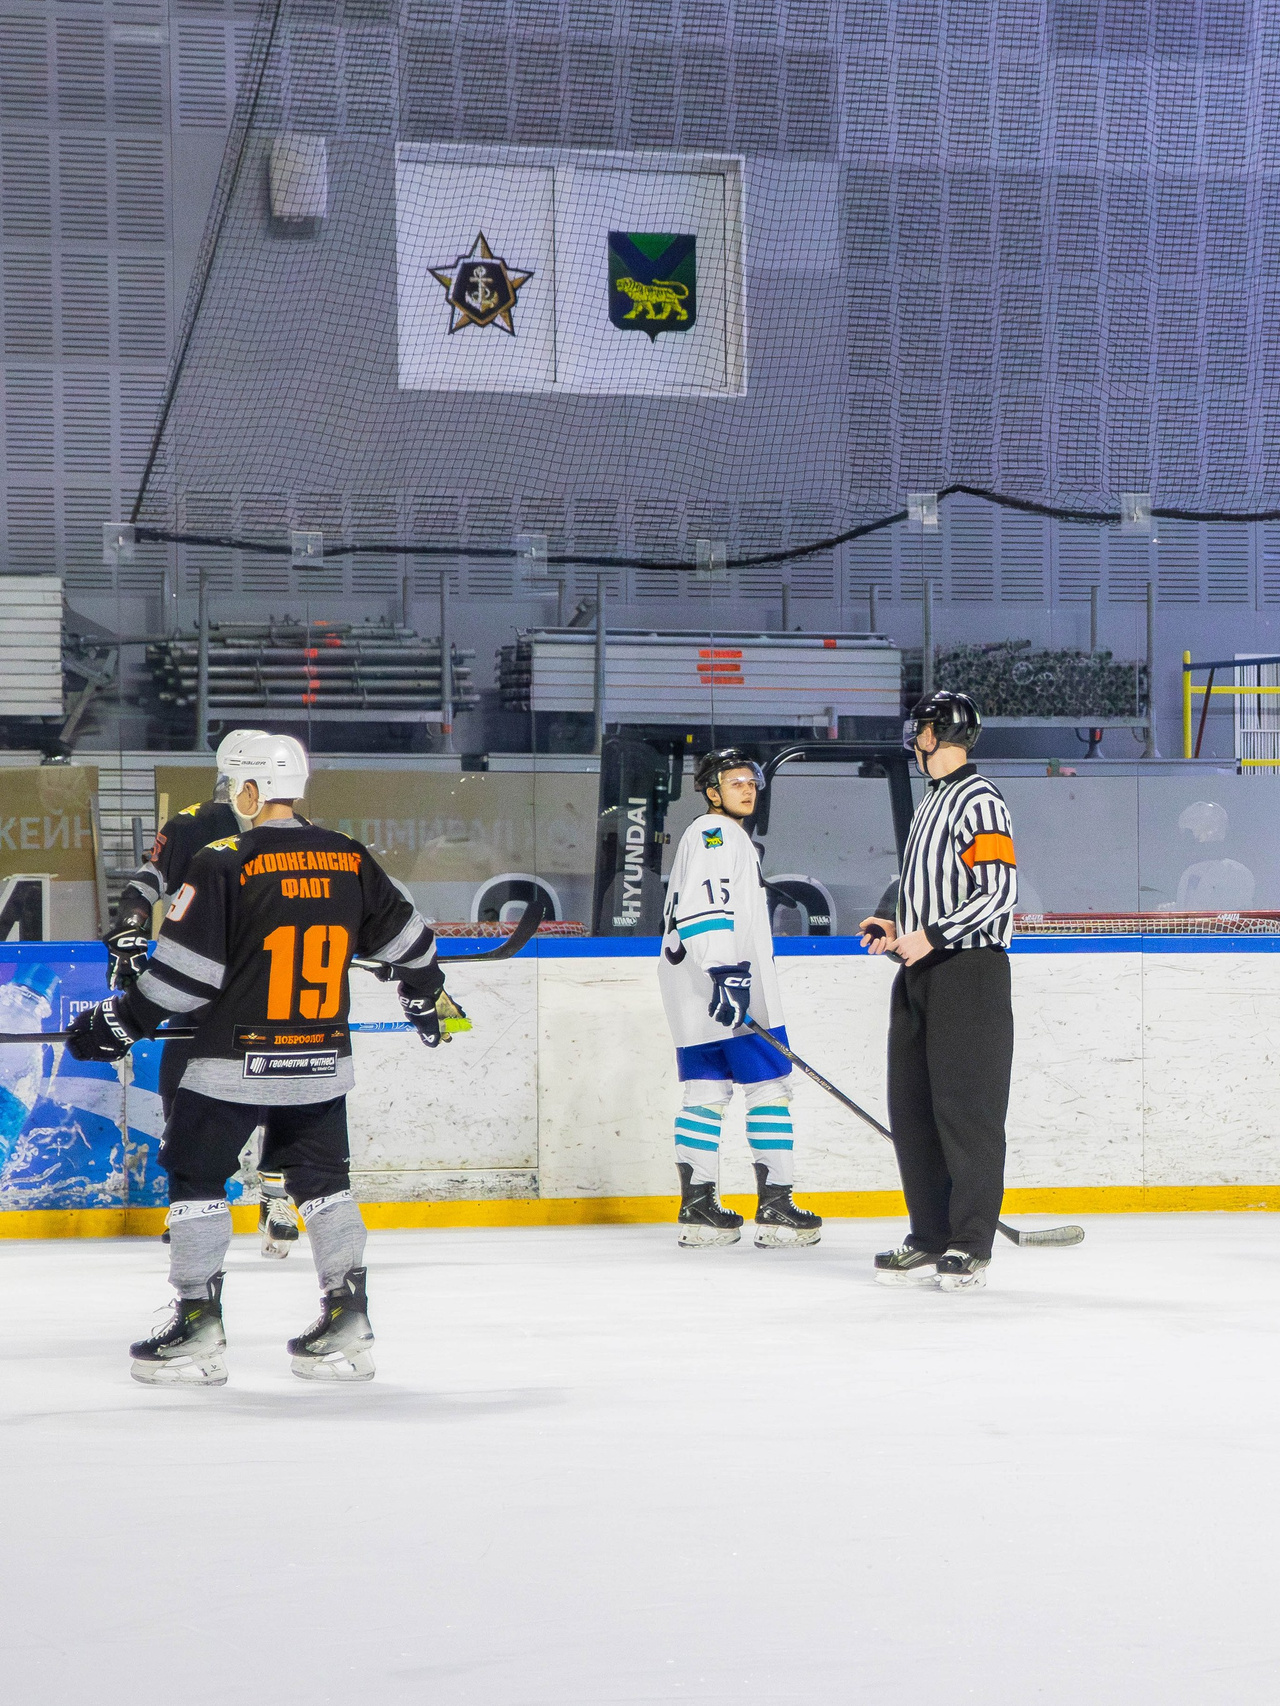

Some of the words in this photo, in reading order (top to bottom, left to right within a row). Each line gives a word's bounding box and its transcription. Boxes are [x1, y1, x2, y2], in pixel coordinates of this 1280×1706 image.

[622, 797, 647, 918] HYUNDAI
[281, 877, 331, 899] ФЛОТ
[701, 878, 730, 905] 15
[117, 936, 148, 947] CC
[263, 925, 349, 1020] 19
[724, 976, 751, 987] CC
[102, 1000, 134, 1046] AUER
[274, 1033, 325, 1045] ДОБРОФЛОТ
